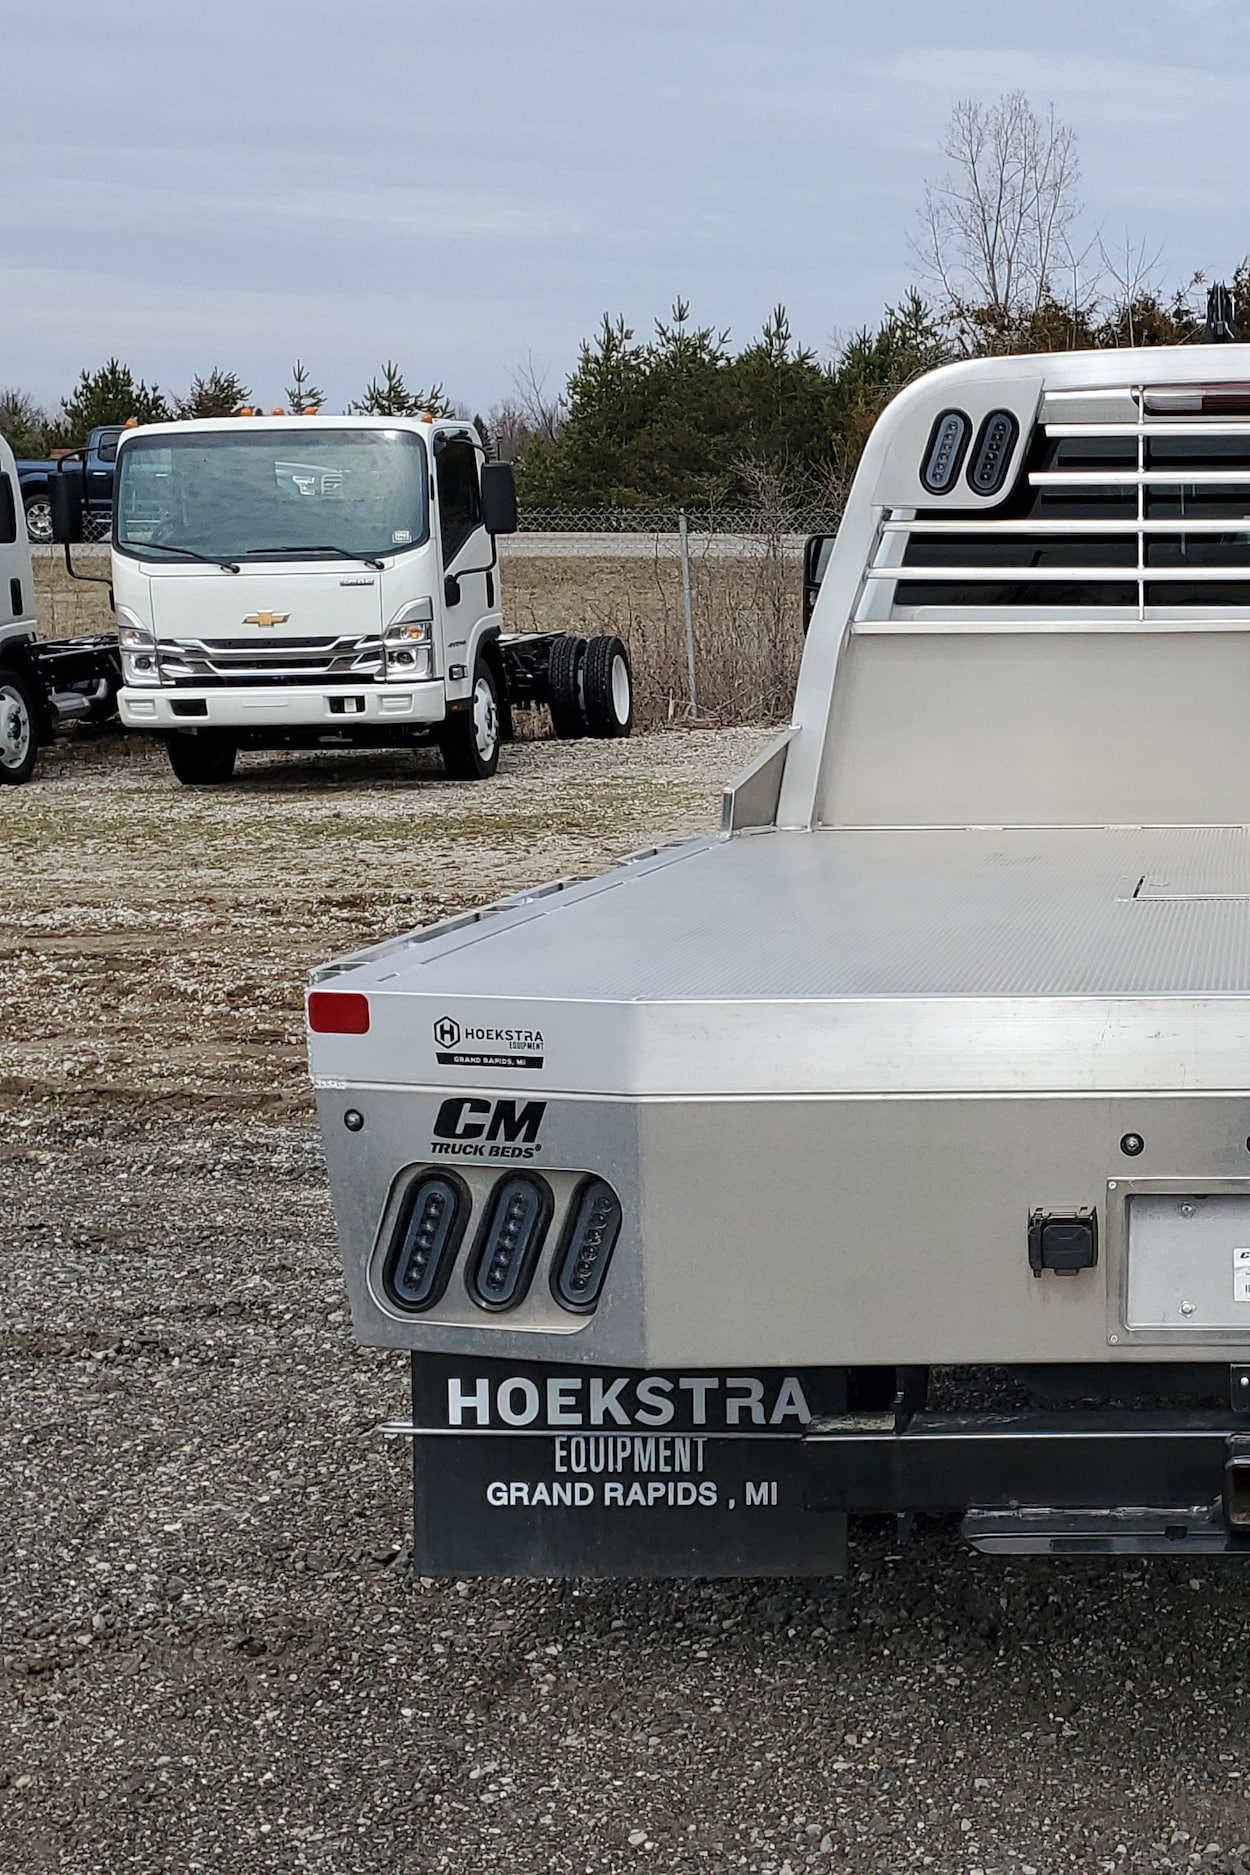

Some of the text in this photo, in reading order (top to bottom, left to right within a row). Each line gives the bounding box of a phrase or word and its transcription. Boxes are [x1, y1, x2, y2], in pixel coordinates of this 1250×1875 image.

[465, 1028, 544, 1041] HOEKSTRA
[509, 1041, 544, 1051] EQUIPMENT
[483, 1057, 515, 1066] RAPIDS,
[433, 1098, 547, 1142] CM
[431, 1142, 485, 1156] TRUCK
[447, 1377, 812, 1426] HOEKSTRA
[554, 1435, 708, 1473] EQUIPMENT
[486, 1481, 594, 1506] GRAND
[603, 1481, 718, 1506] RAPIDS
[745, 1481, 778, 1506] MI
